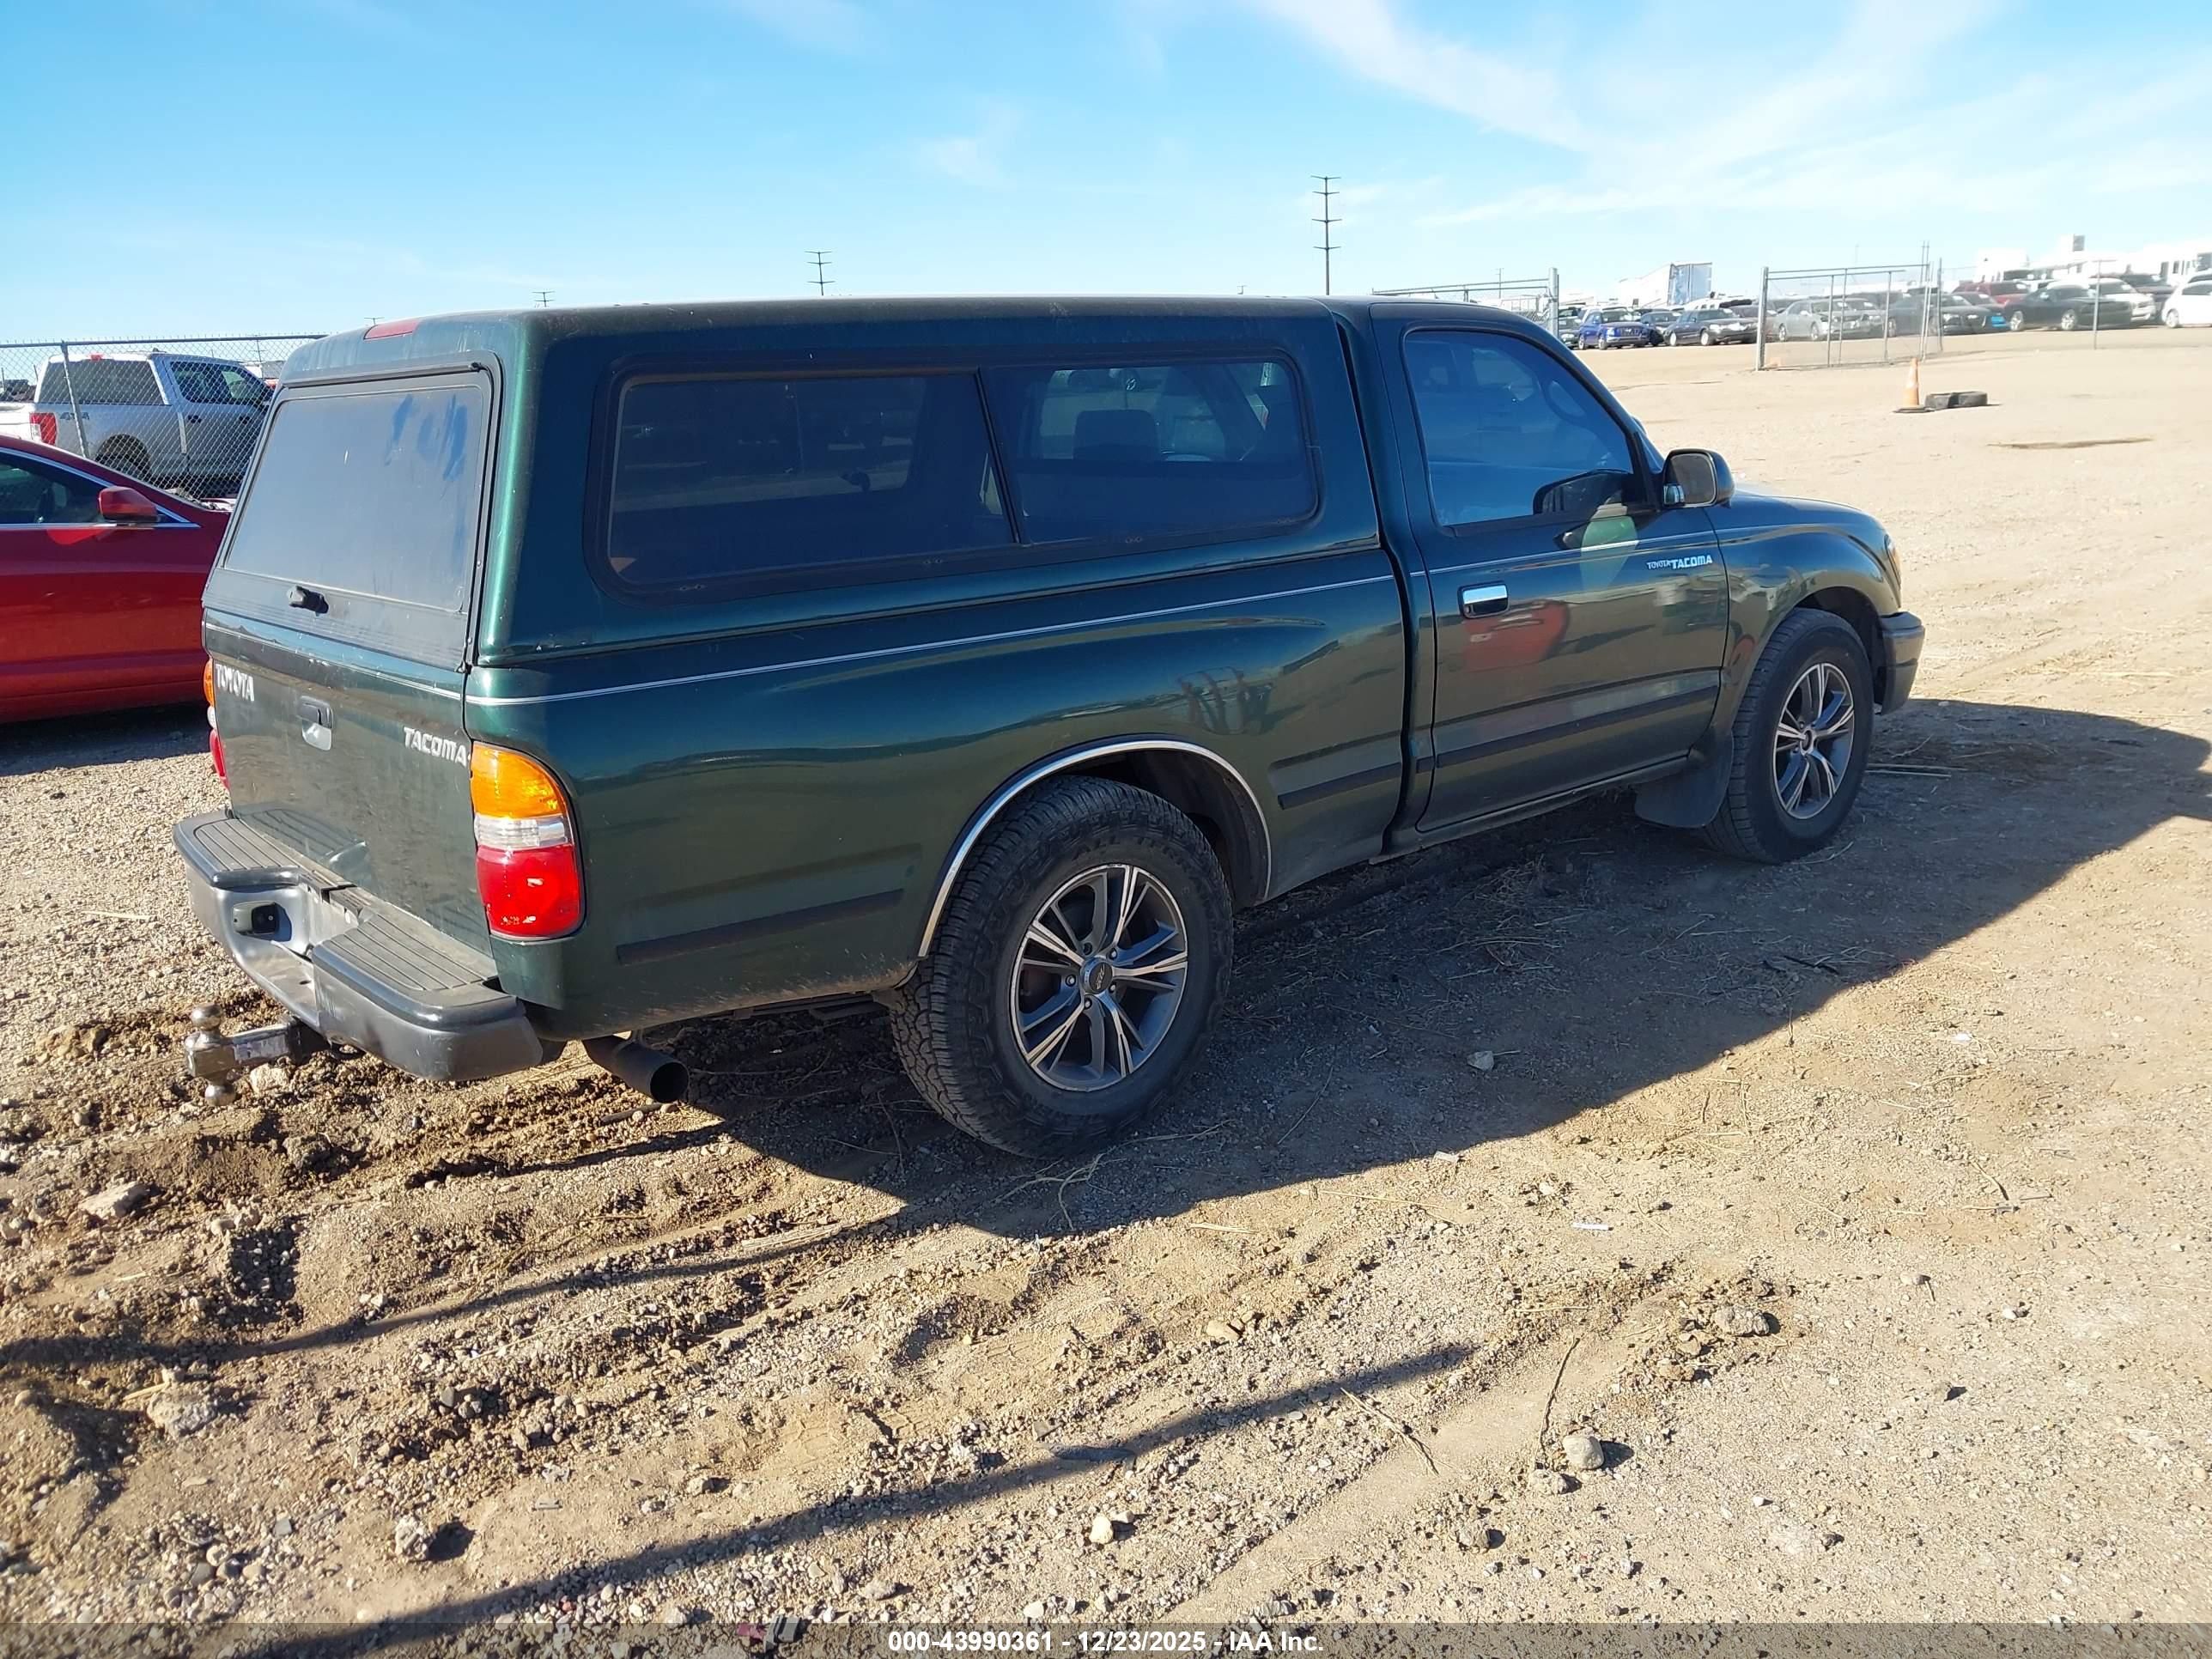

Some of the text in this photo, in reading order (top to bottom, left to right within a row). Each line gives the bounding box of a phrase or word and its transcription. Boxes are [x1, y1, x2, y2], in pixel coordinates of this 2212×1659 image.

[1647, 555, 1713, 569] TOYOTA TACOMA
[216, 663, 255, 702] TOYOTA
[404, 726, 467, 767] TACOMA
